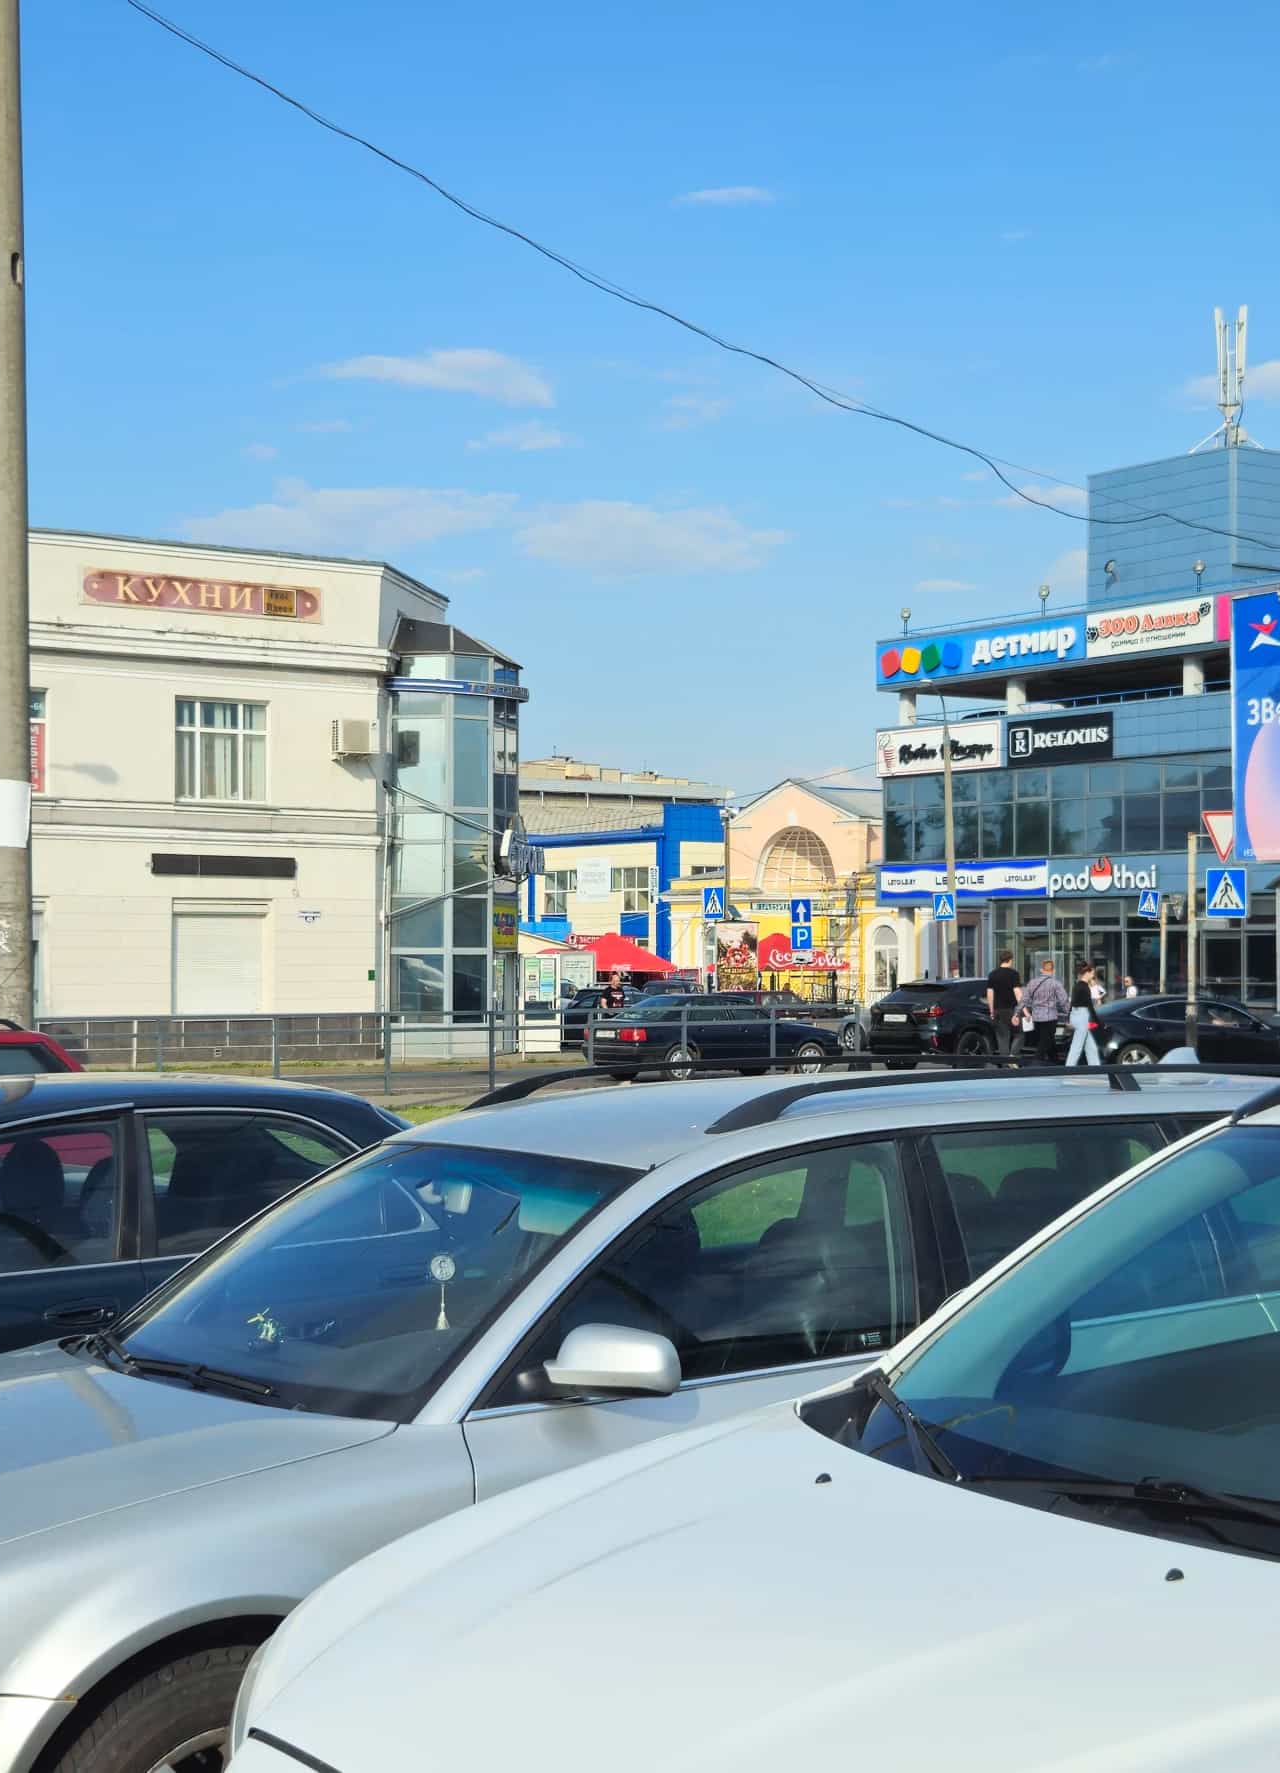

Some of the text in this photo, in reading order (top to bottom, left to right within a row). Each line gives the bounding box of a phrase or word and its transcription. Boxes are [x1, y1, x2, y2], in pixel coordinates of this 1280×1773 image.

[116, 576, 254, 610] КУХНИ
[1099, 614, 1139, 639] ЗОО
[971, 627, 1076, 667] детмир
[935, 875, 985, 886] LEOILE
[1049, 863, 1157, 898] pad thai
[769, 948, 847, 968] CocCola
